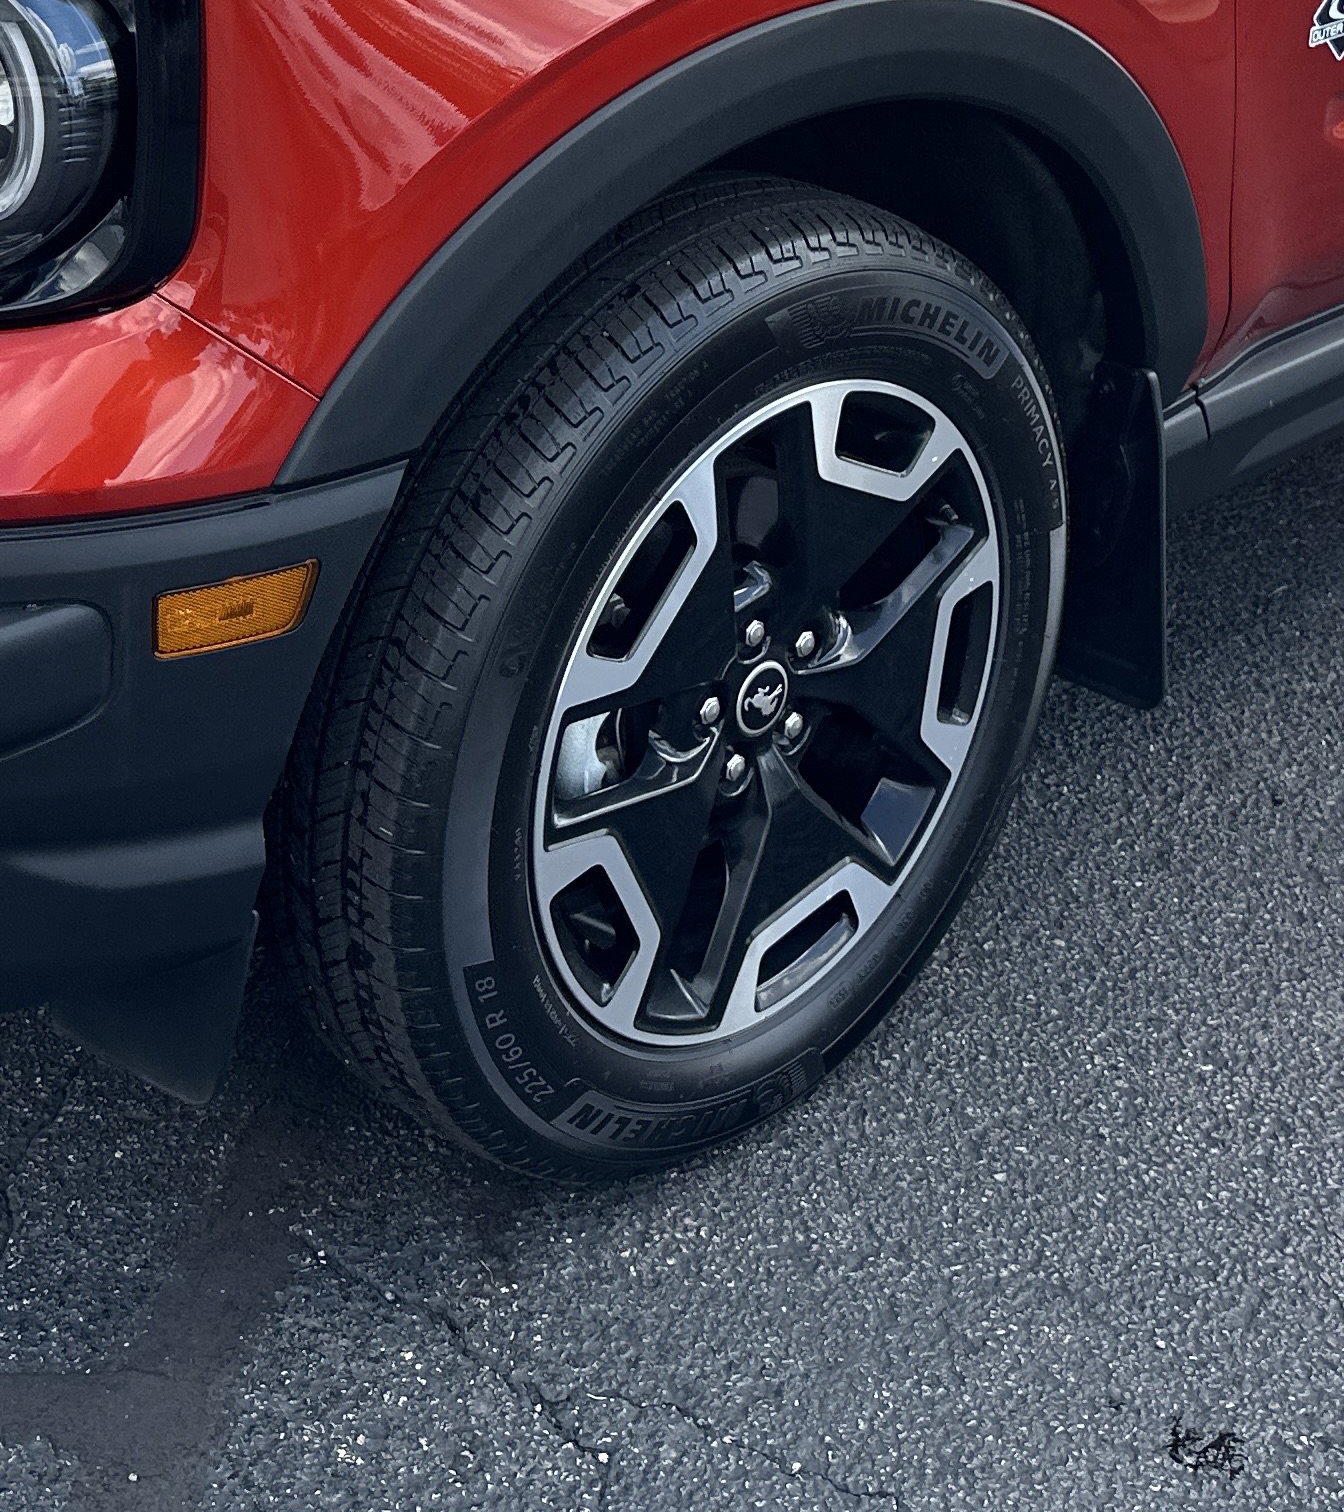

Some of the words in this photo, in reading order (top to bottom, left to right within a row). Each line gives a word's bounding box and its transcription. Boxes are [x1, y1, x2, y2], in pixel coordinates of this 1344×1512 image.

[1312, 23, 1344, 41] OUTER
[858, 296, 1000, 367] MICHELIN
[1009, 375, 1054, 468] PRIMACY
[475, 976, 498, 1003] 18
[485, 1008, 508, 1030] R
[495, 1032, 555, 1103] 225/60
